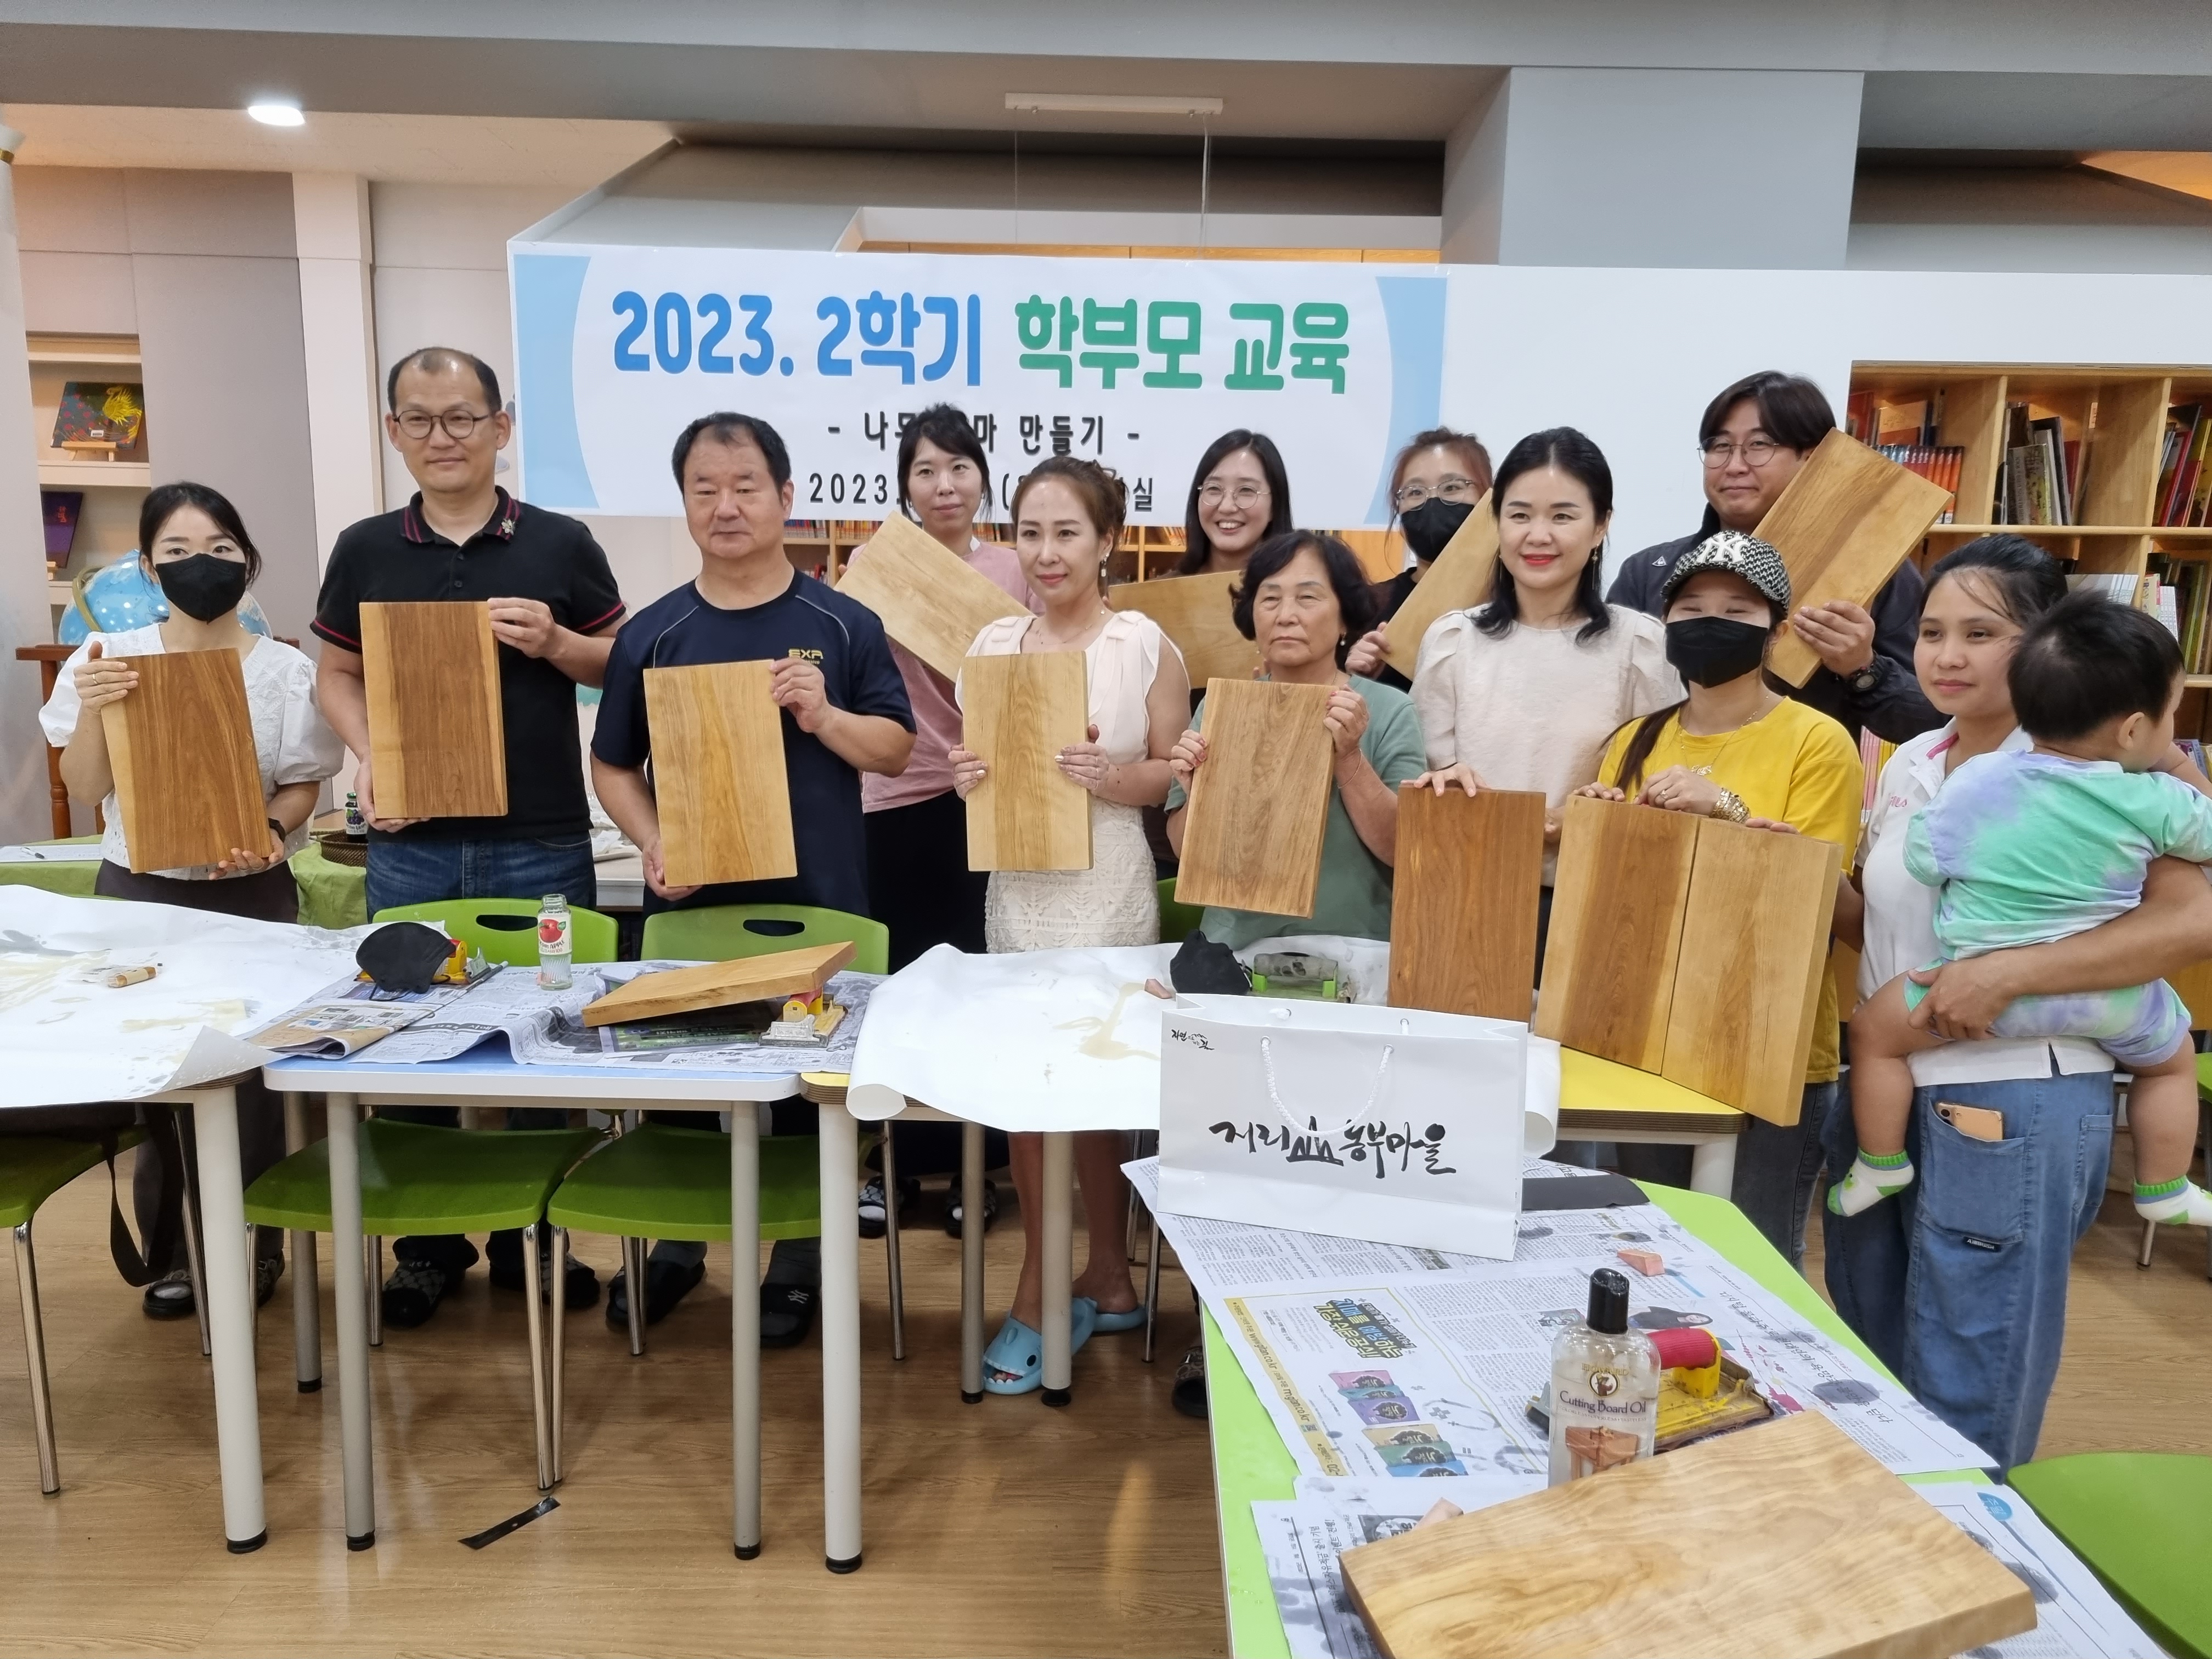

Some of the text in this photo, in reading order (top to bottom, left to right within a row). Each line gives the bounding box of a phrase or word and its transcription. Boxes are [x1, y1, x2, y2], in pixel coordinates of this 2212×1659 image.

[612, 290, 1350, 394] 2023. 2학기 학부모 교육
[973, 413, 998, 454] 마
[1019, 414, 1104, 456] 만들기
[550, 939, 565, 950] APPLE
[1559, 1390, 1646, 1414] Cutting Board Oil
